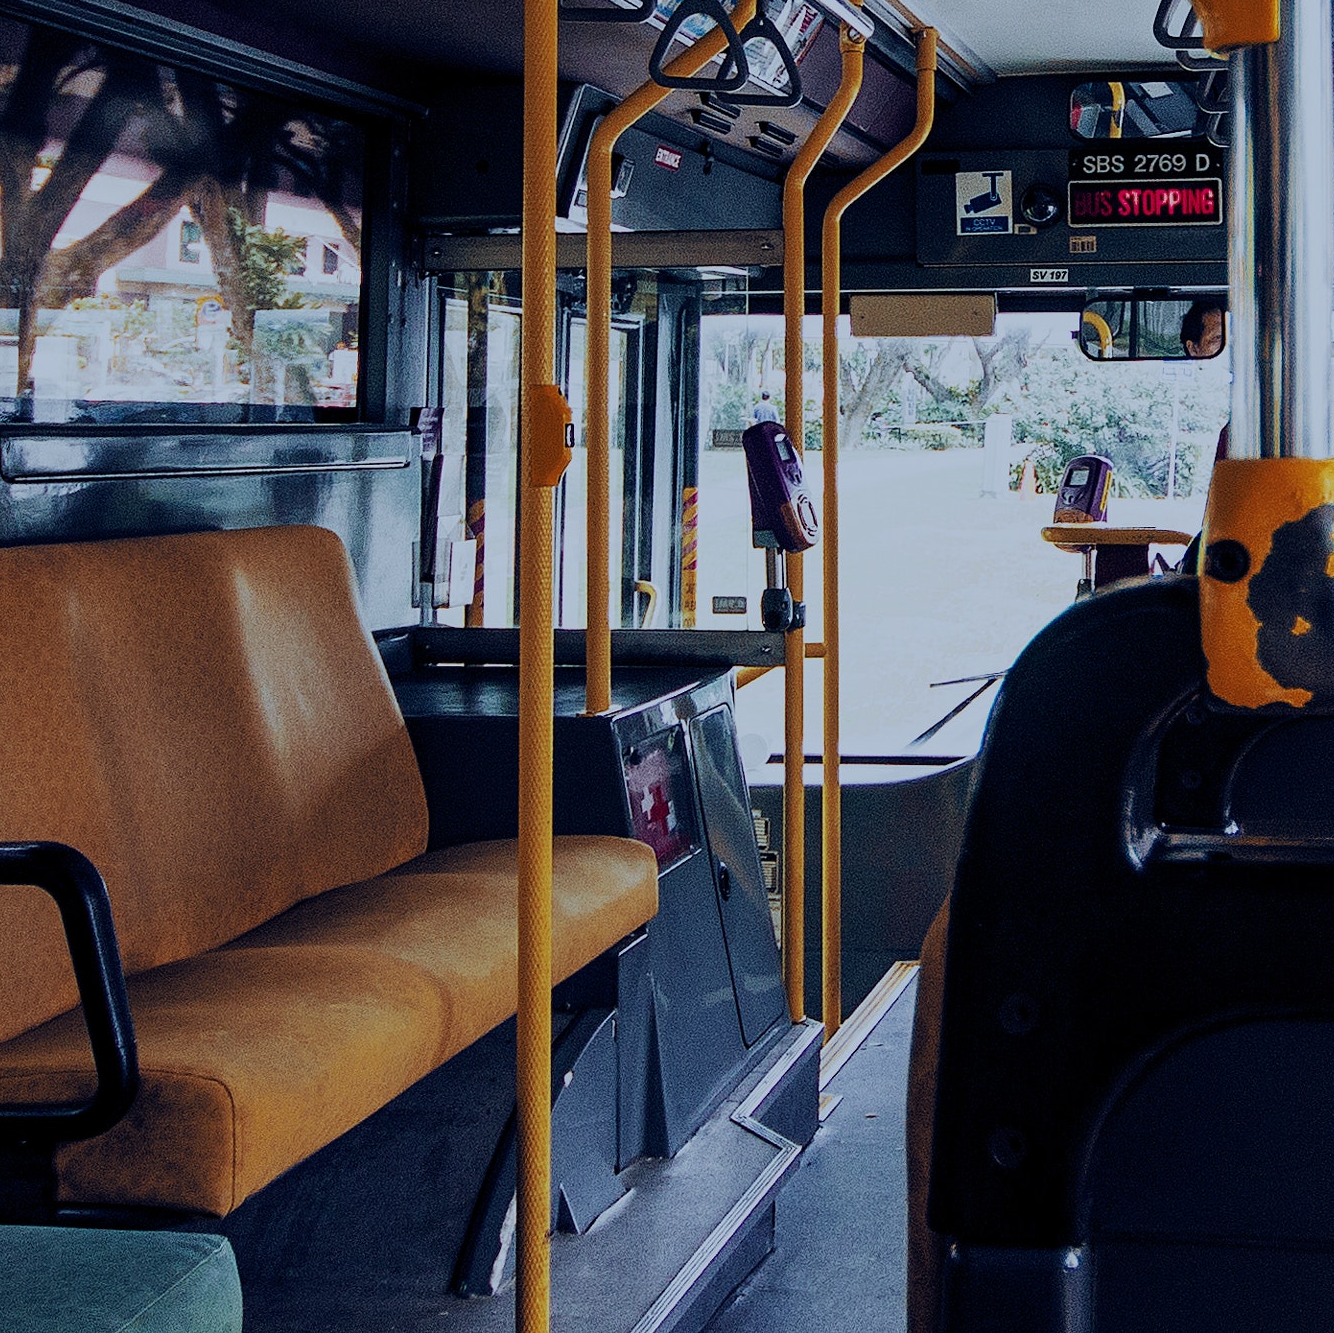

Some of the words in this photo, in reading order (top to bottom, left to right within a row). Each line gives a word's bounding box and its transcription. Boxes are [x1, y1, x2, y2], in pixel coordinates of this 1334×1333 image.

[1082, 155, 1125, 174] SBS
[1133, 153, 1187, 173] 2769
[1195, 153, 1211, 172] D
[1074, 191, 1113, 217] BUS
[1118, 188, 1215, 216] STOPPING
[973, 218, 997, 227] CCTV
[1031, 270, 1048, 280] SV
[1048, 270, 1067, 280] 197
